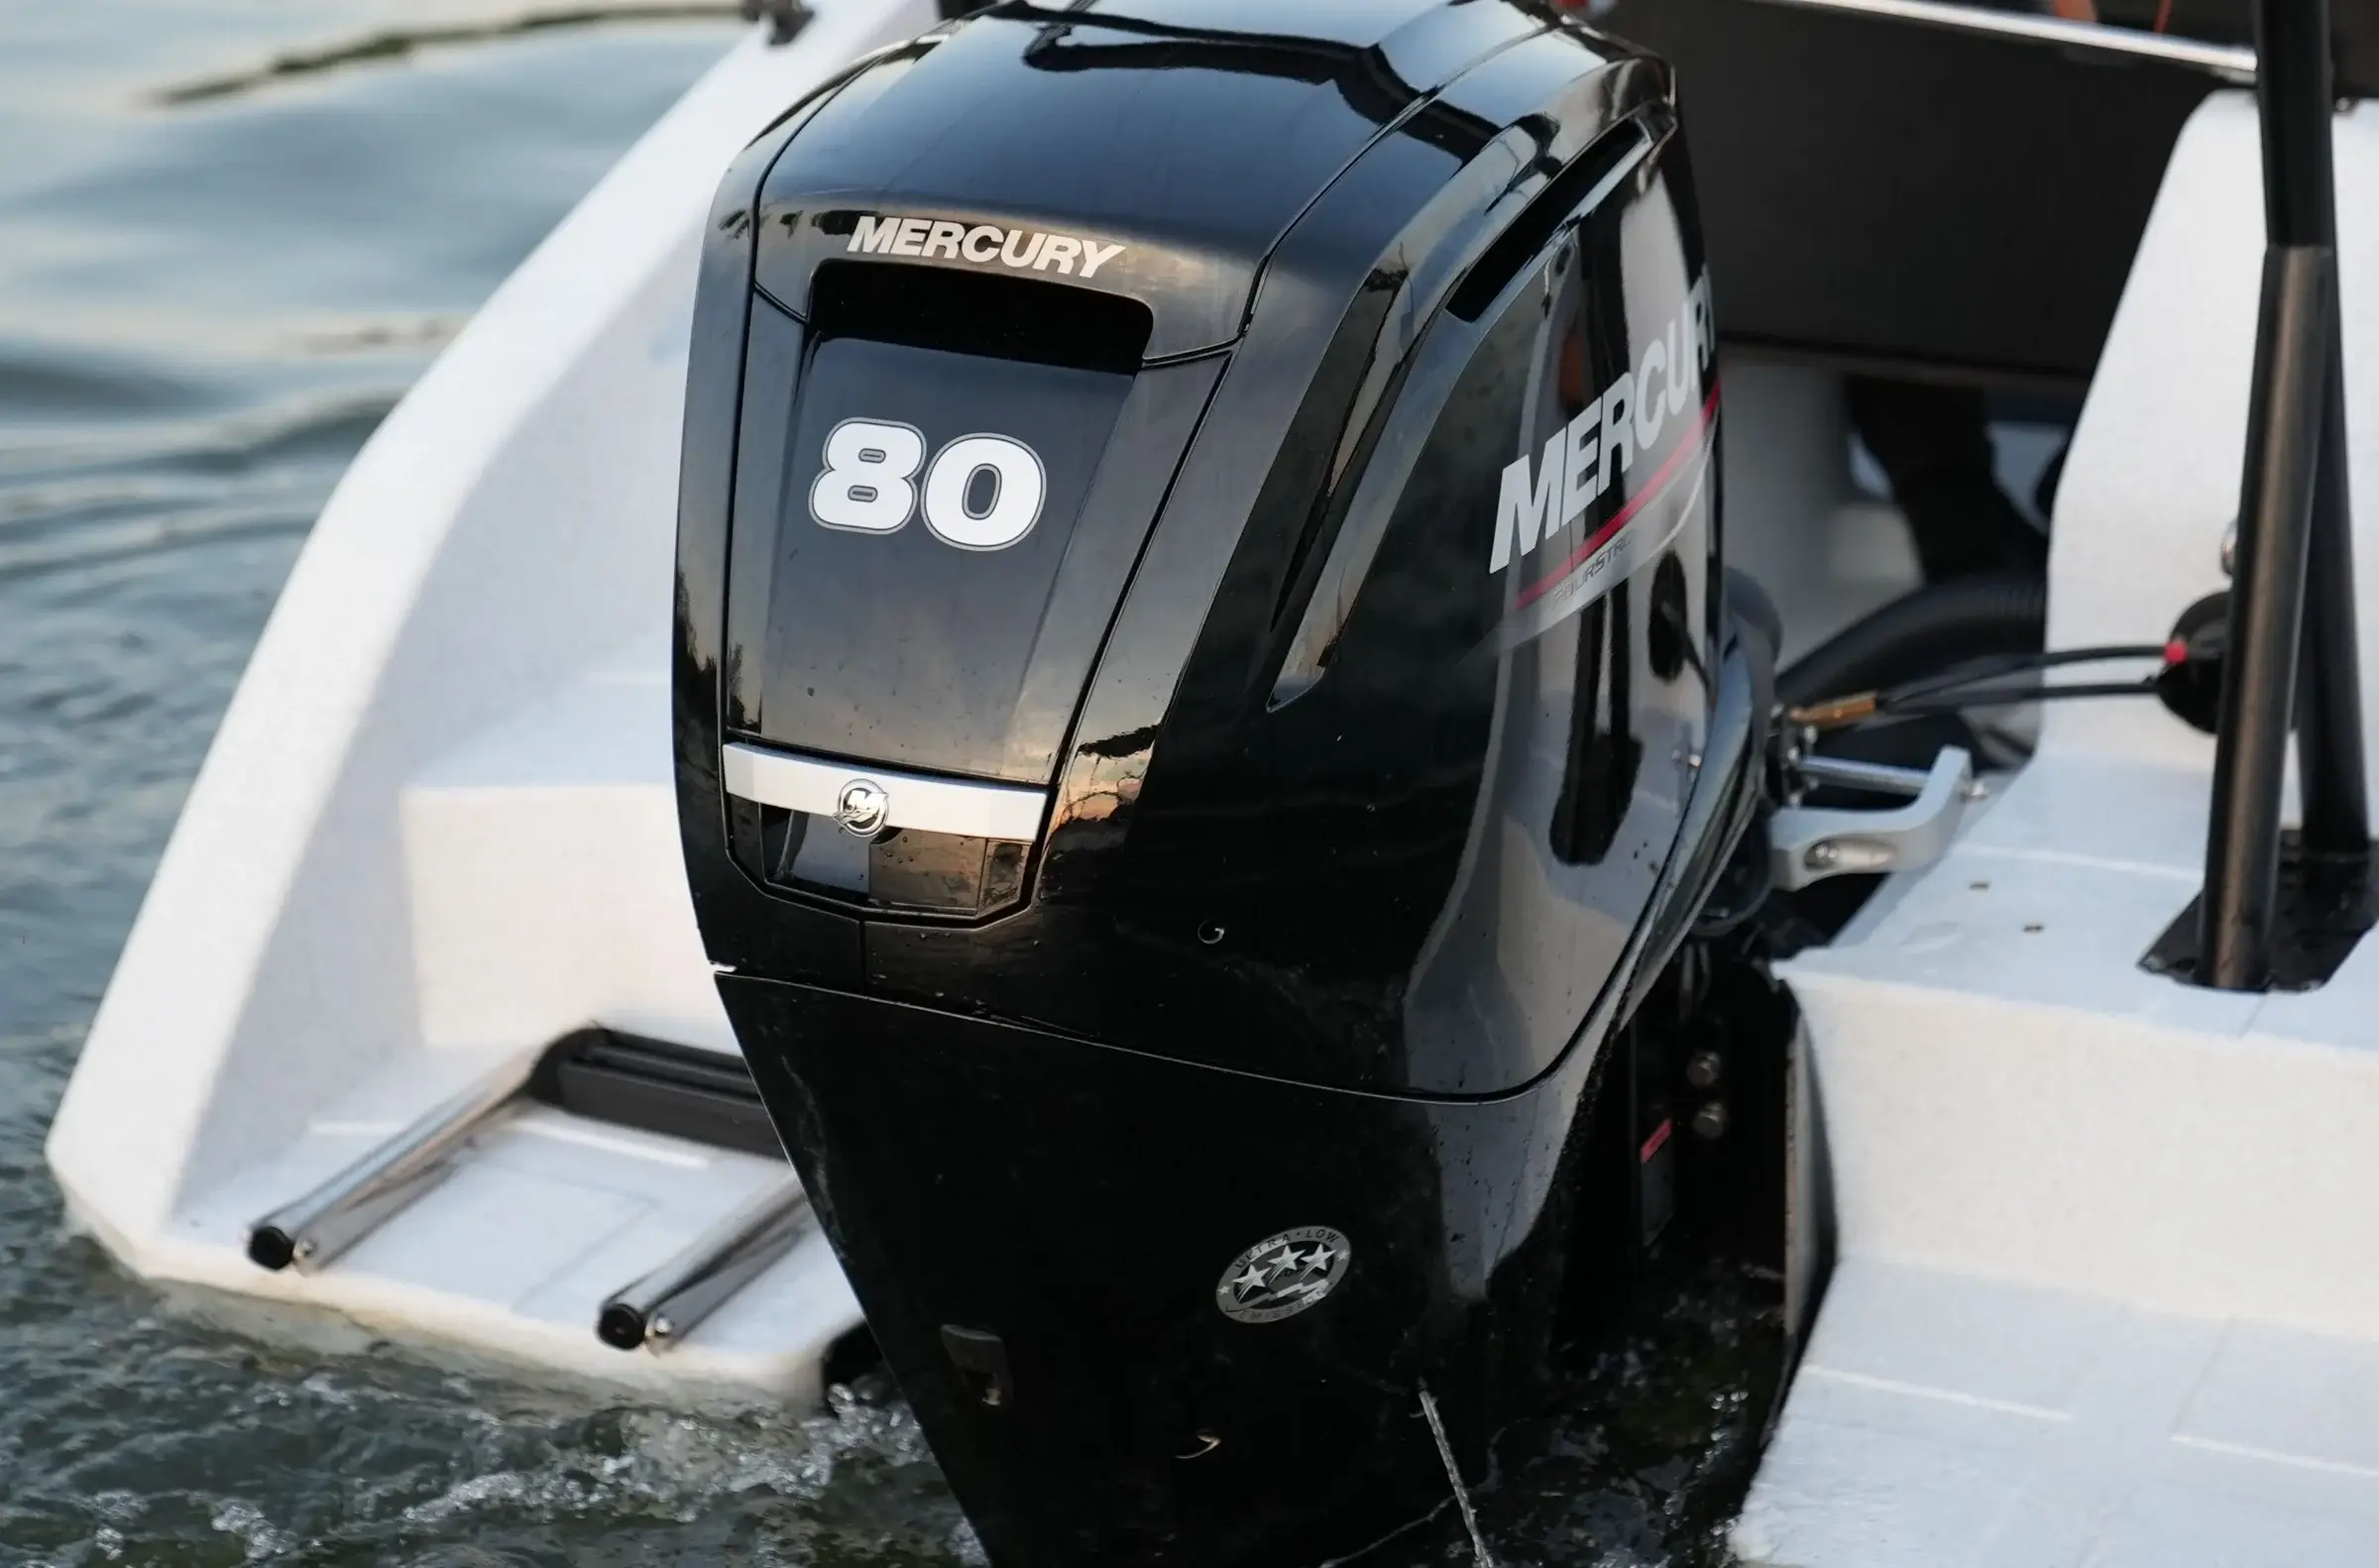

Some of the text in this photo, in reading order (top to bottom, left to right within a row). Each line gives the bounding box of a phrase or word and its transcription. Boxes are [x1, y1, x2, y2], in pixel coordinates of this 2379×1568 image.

[847, 216, 1125, 278] MERCURY
[809, 417, 1046, 551] 80
[1236, 1229, 1339, 1268] ULTRA LOW
